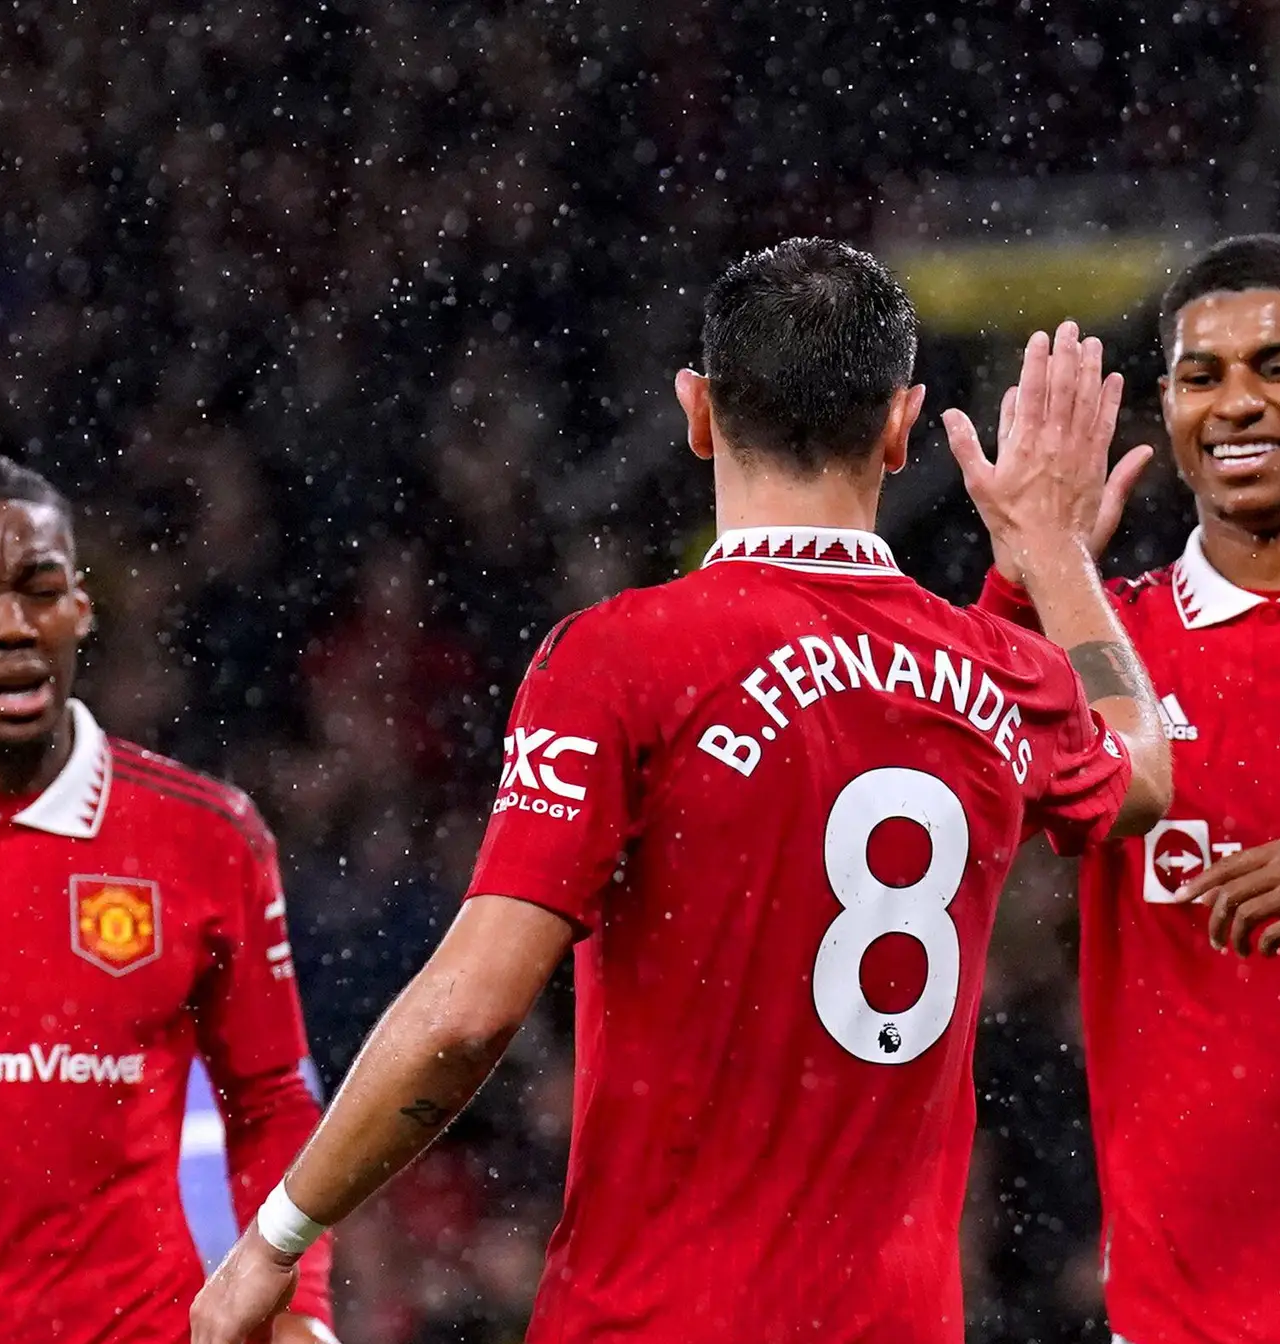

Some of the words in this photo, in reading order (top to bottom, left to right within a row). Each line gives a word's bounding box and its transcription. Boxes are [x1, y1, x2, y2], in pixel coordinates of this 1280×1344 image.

[697, 633, 1033, 785] B.FERNANDES
[1163, 722, 1198, 741] das
[812, 766, 970, 1065] 8
